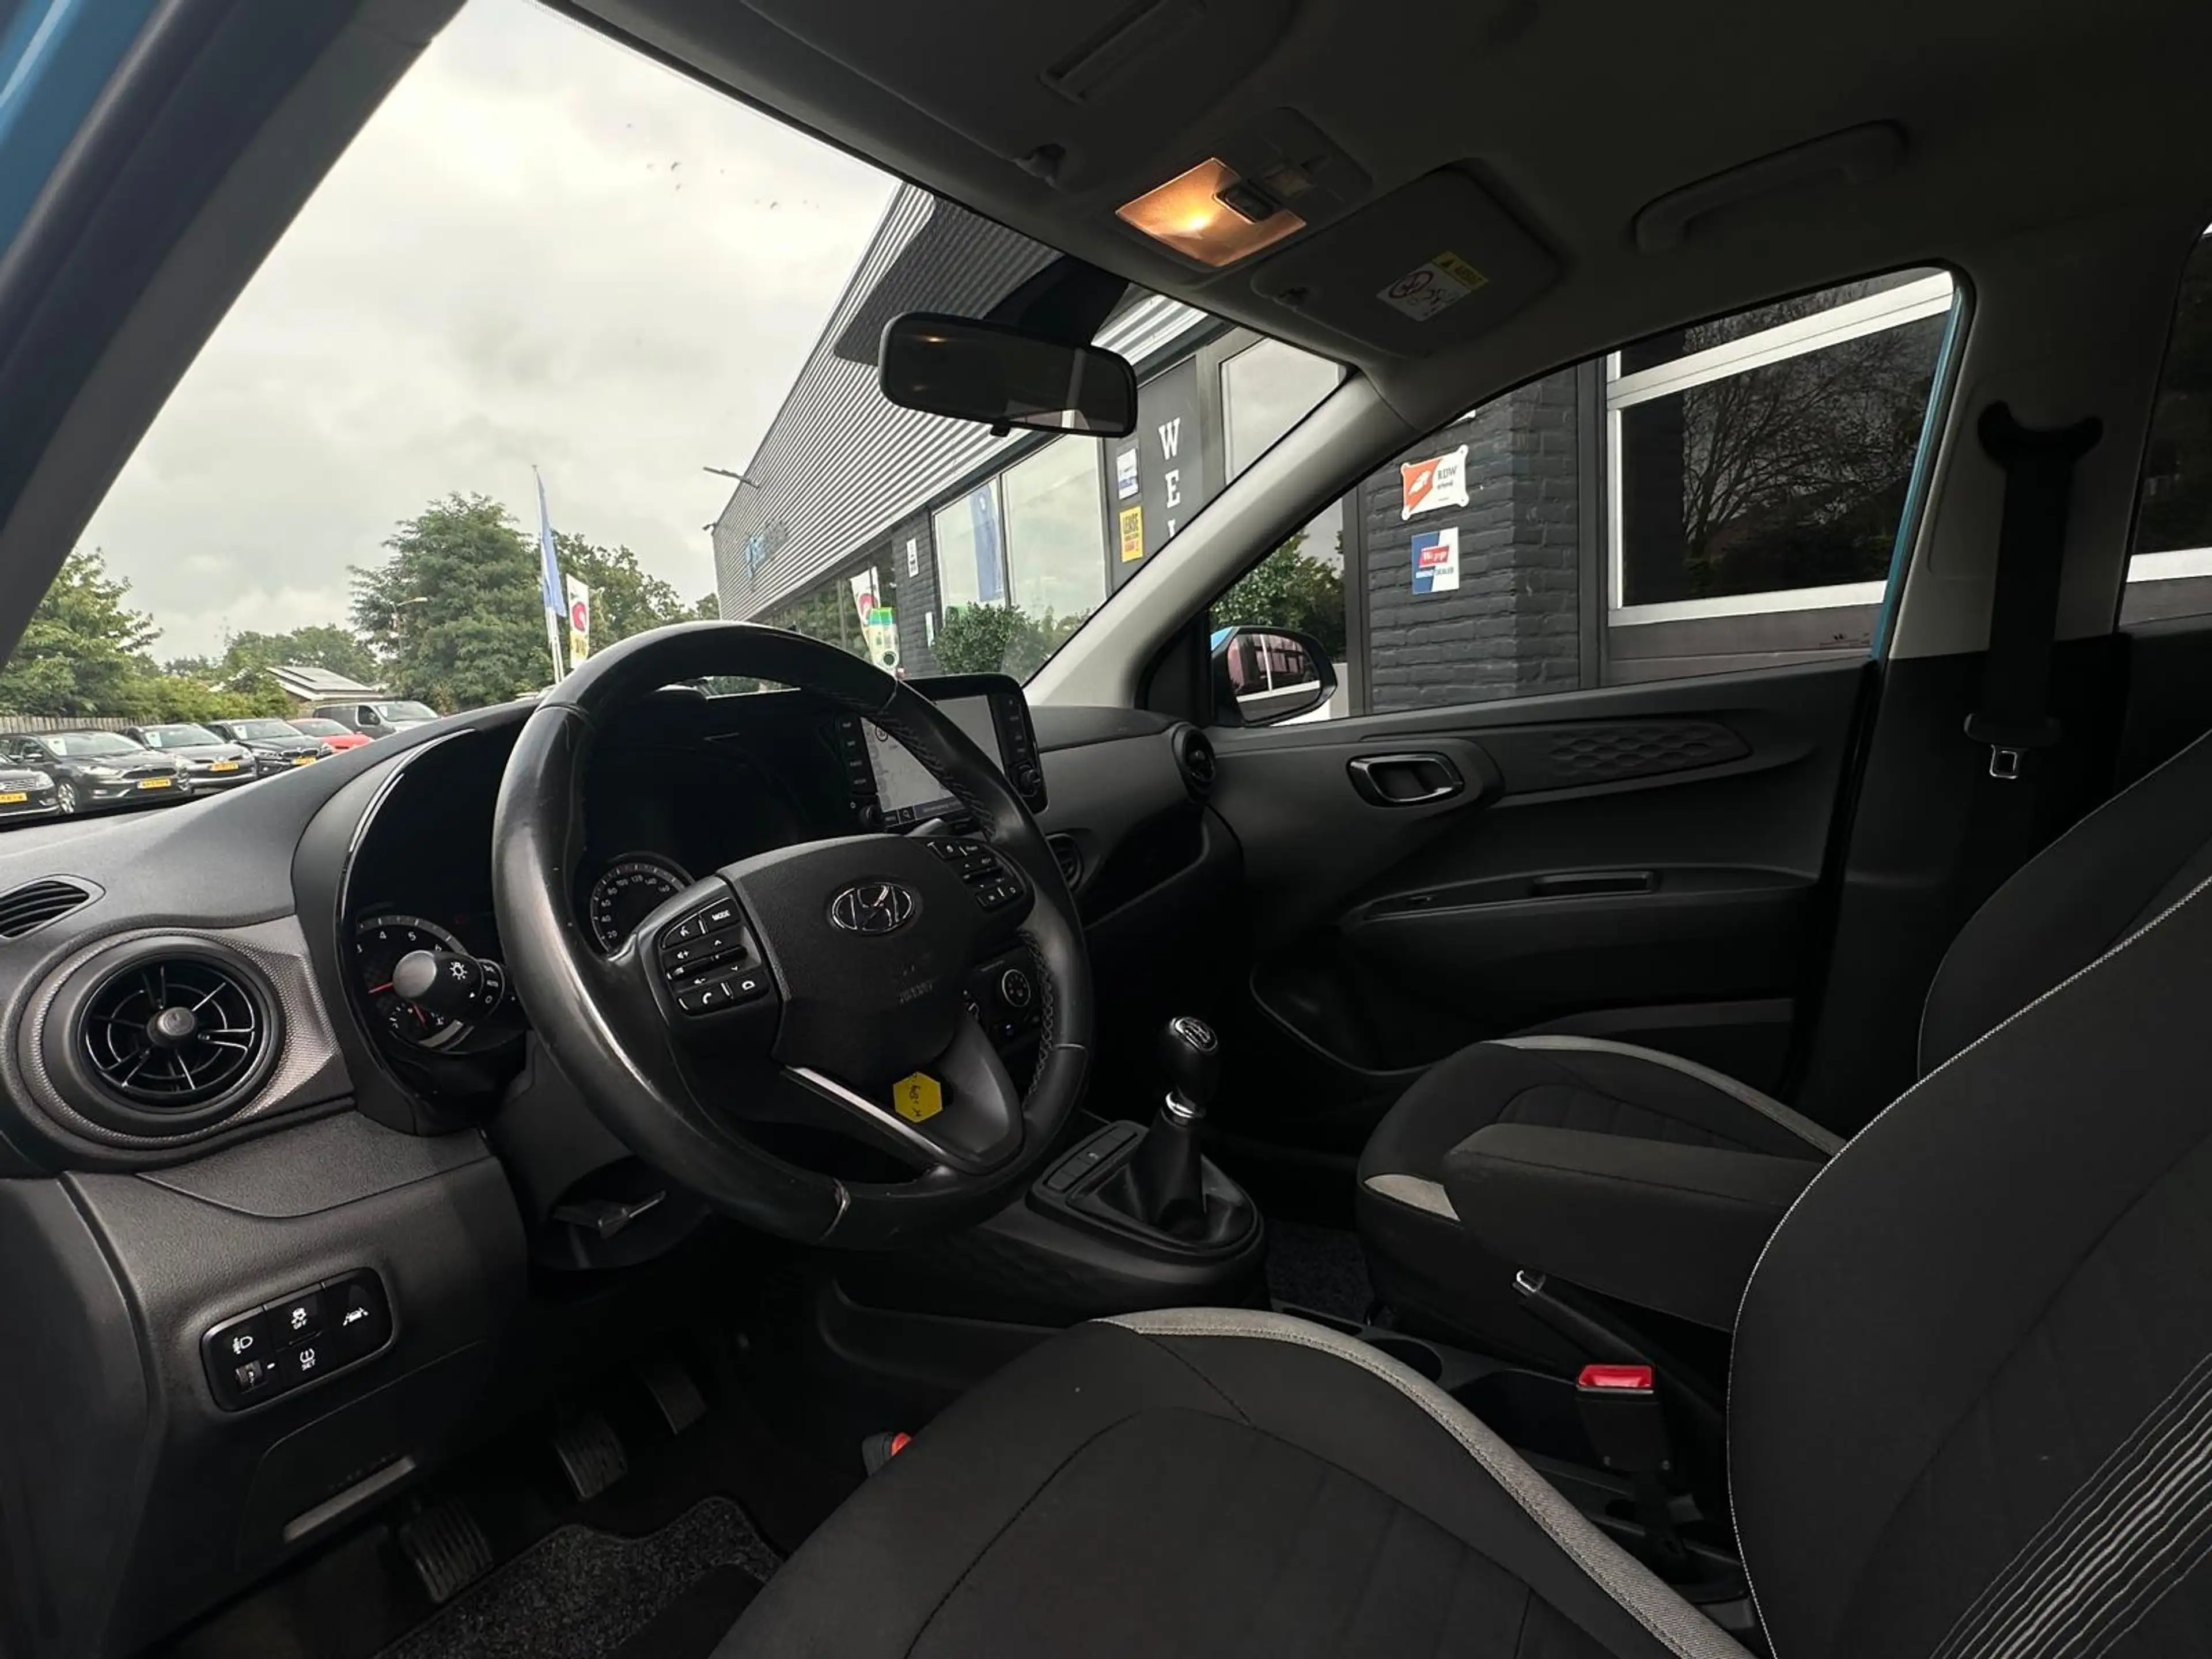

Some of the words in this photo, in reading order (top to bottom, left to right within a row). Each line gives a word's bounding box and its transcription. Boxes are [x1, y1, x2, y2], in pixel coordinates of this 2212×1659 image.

[601, 899, 611, 907] 60
[711, 910, 730, 921] MODE
[379, 930, 387, 941] 4
[407, 931, 416, 941] 5
[607, 930, 618, 938] 20
[355, 944, 363, 954] 3
